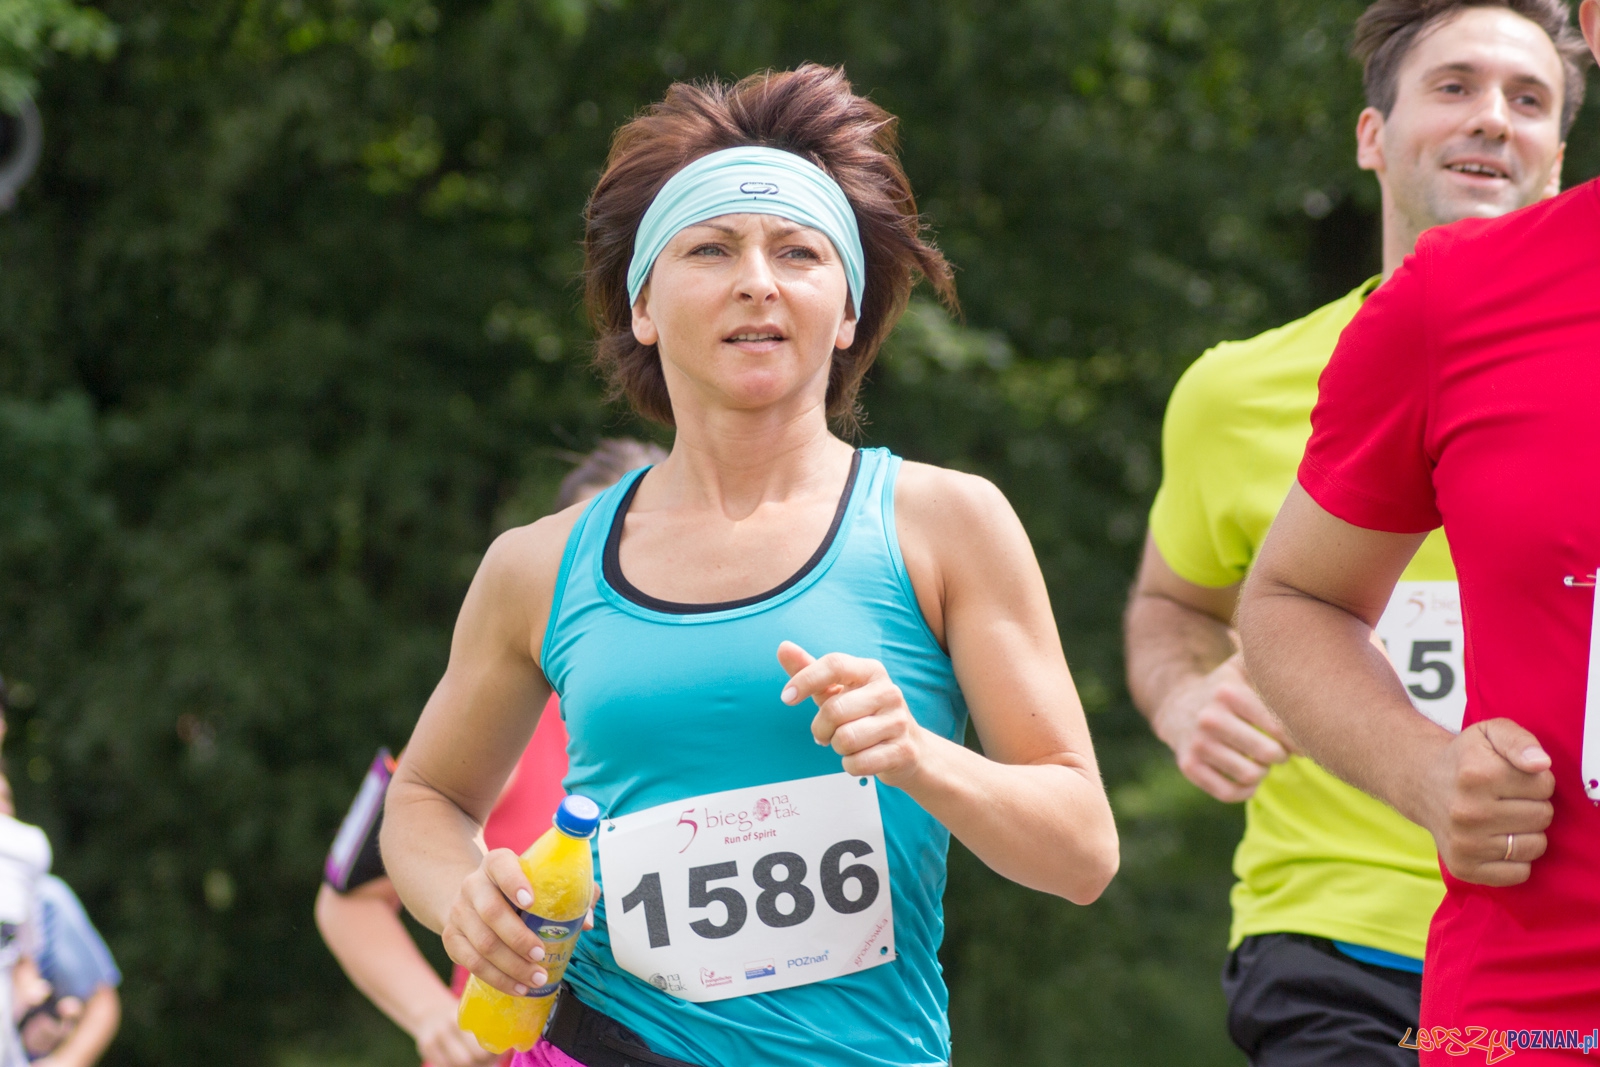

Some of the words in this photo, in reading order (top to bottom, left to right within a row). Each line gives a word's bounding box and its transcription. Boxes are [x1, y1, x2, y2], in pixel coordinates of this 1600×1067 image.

[771, 794, 790, 806] na
[774, 803, 801, 819] tak
[676, 808, 699, 854] 5
[704, 807, 753, 832] bieg
[724, 834, 742, 845] Run
[743, 832, 752, 842] of
[753, 828, 777, 842] Spirit
[621, 839, 880, 949] 1586
